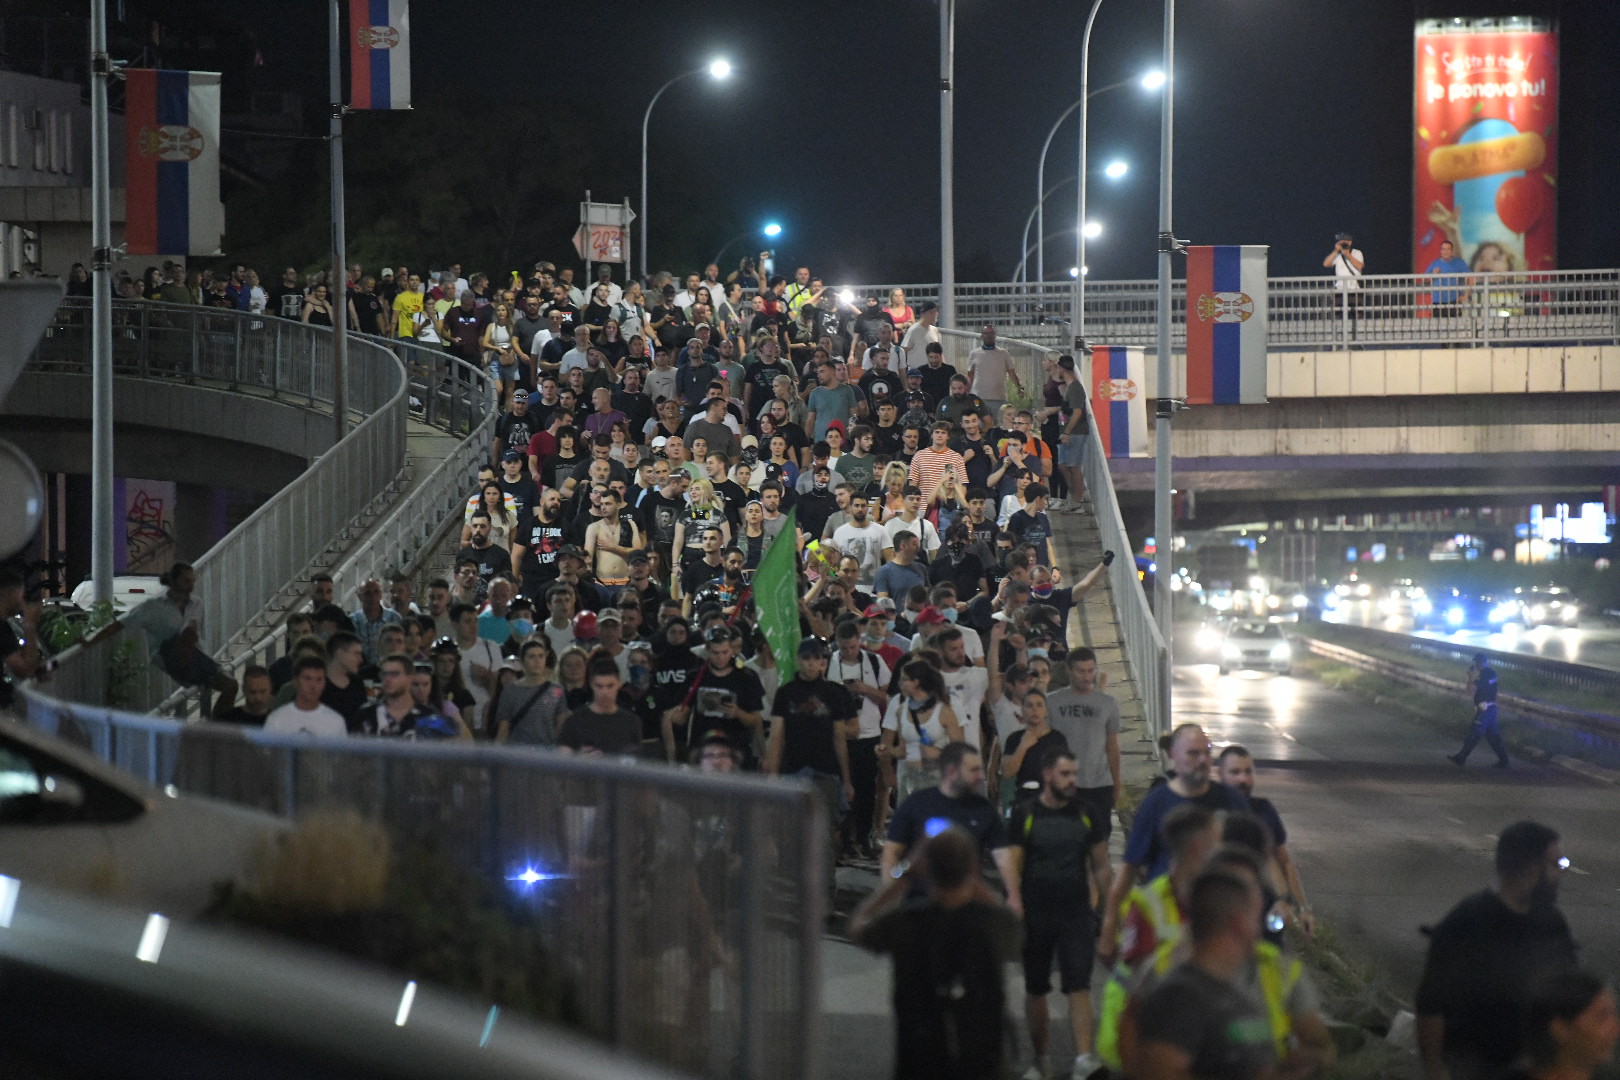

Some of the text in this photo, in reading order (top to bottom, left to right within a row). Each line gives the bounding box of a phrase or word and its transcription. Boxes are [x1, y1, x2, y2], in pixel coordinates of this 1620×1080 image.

[1448, 81, 1518, 103] ponovo
[1520, 78, 1546, 97] tu!
[1058, 703, 1094, 718] VIEW
